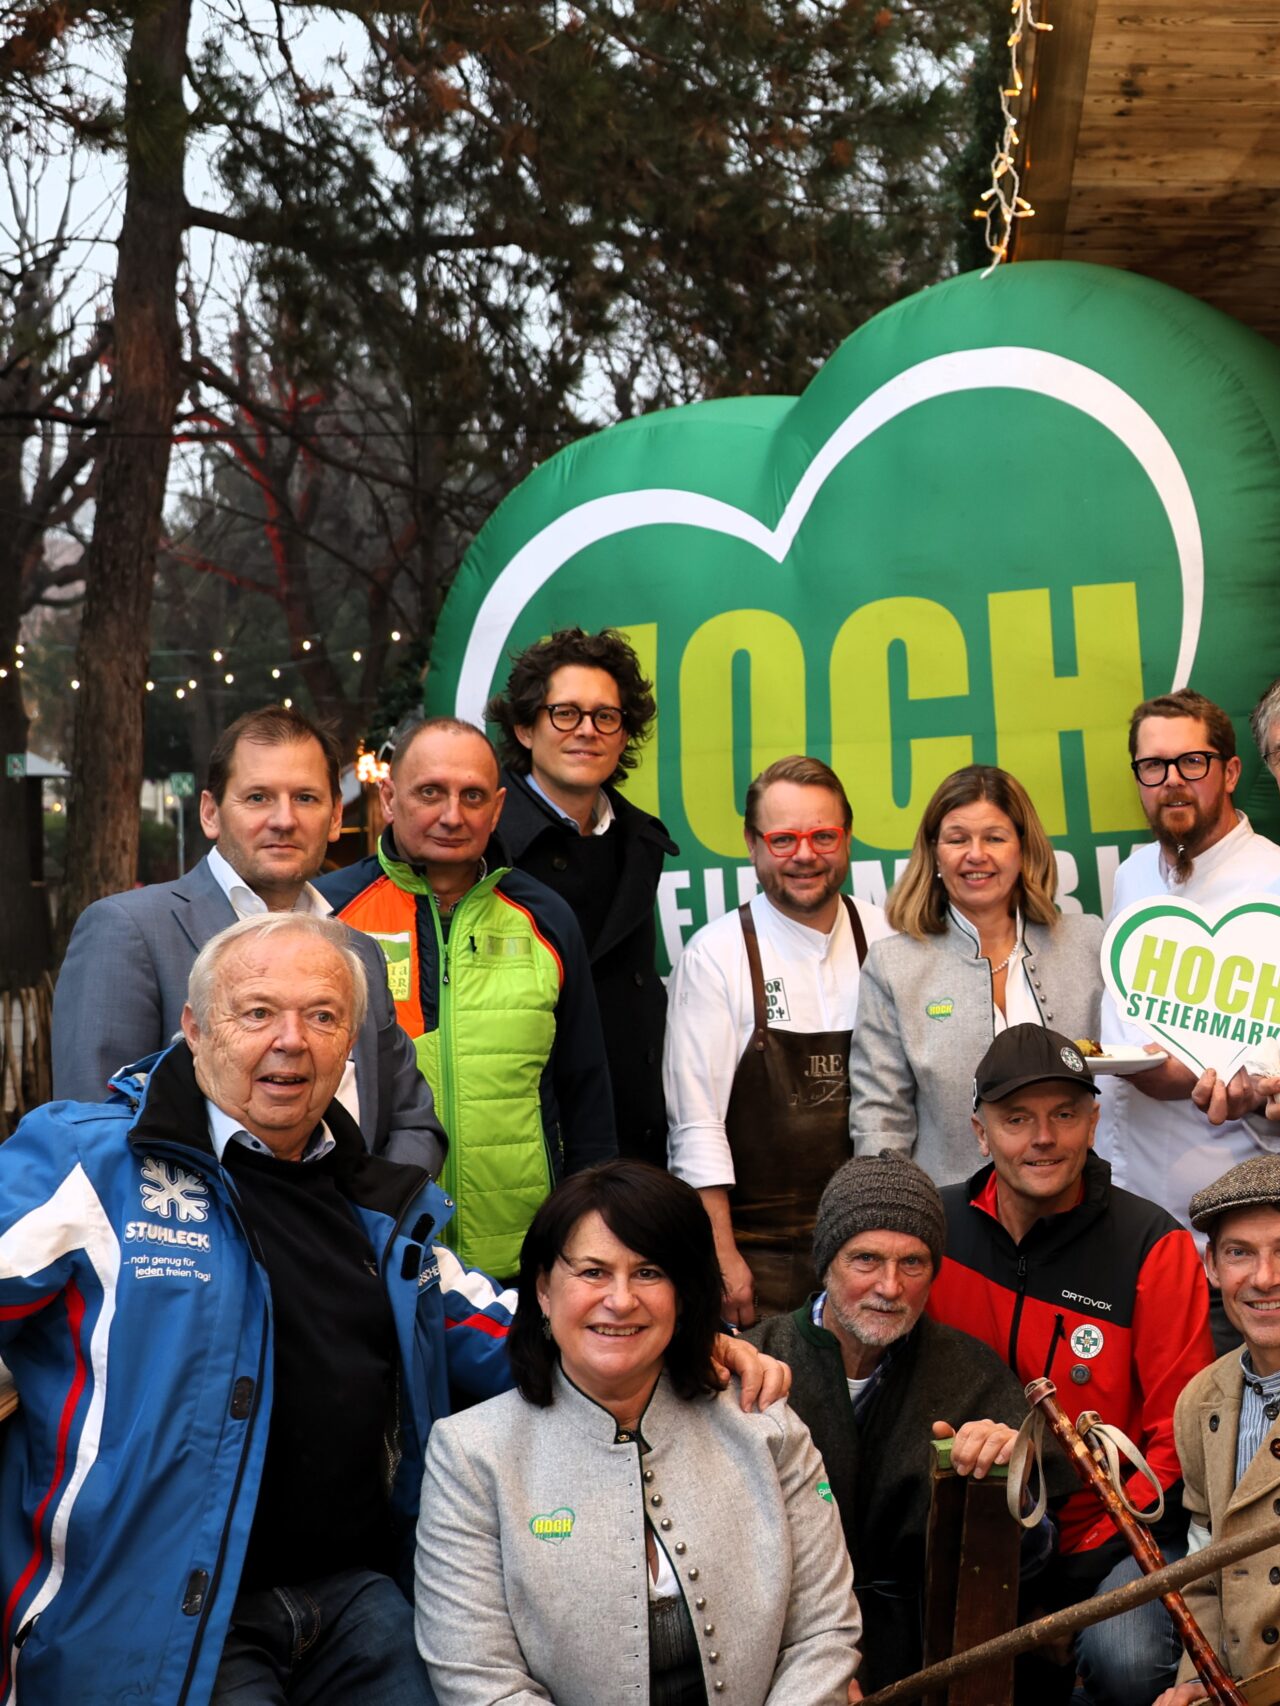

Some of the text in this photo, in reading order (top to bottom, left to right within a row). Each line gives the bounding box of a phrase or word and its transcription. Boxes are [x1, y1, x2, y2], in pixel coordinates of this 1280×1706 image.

[804, 1054, 844, 1076] JRE
[125, 1221, 211, 1252] STUHLECK
[152, 1256, 182, 1267] genug
[183, 1257, 197, 1267] für
[135, 1266, 212, 1283] jeden freien Tag!
[1061, 1289, 1113, 1311] ORTOVOX
[535, 1518, 572, 1534] HOCH
